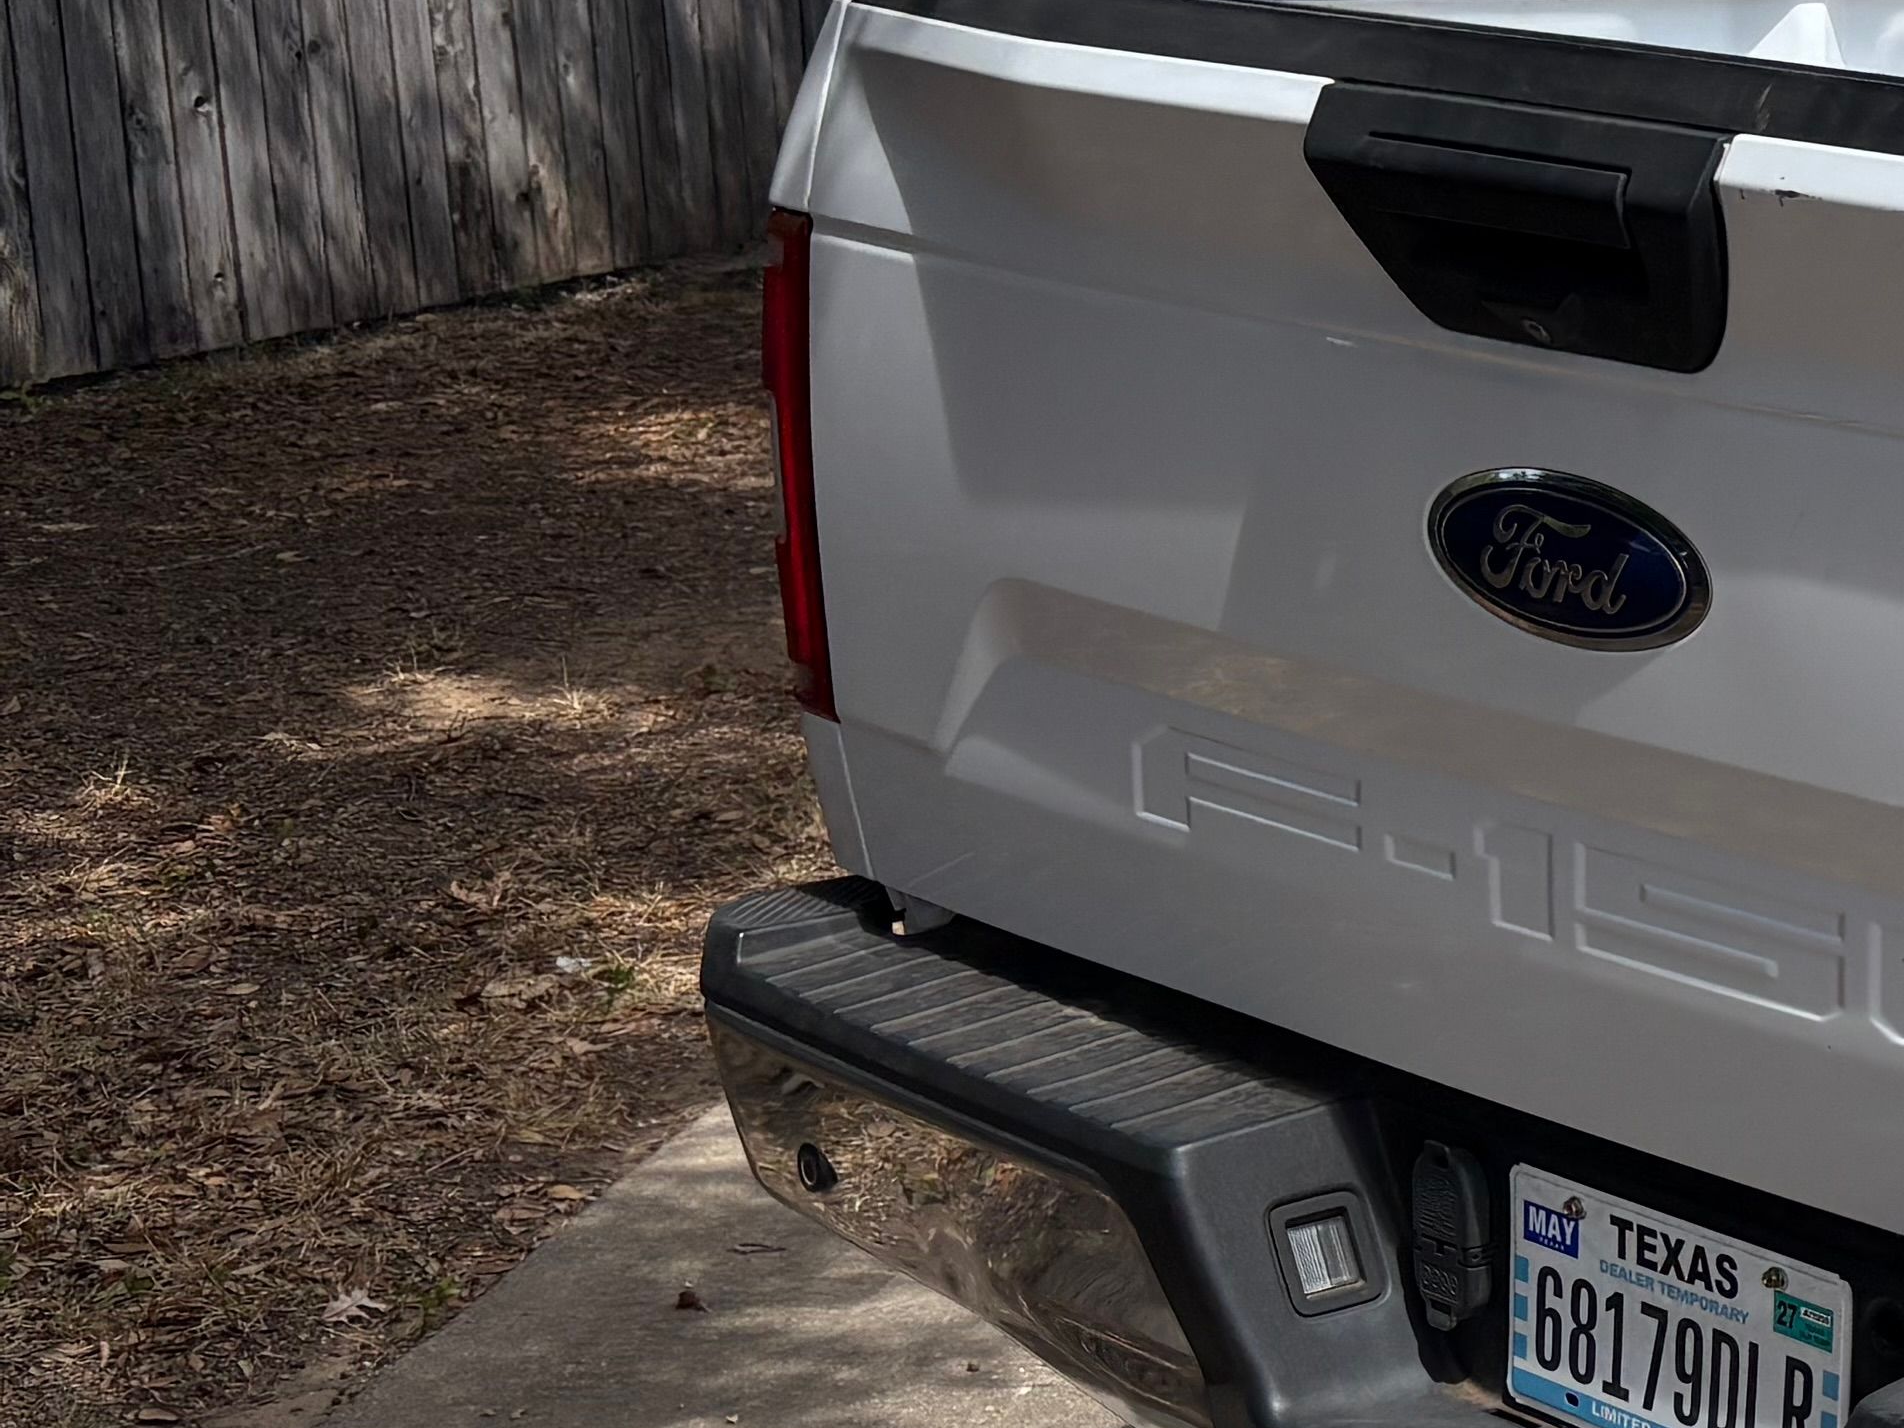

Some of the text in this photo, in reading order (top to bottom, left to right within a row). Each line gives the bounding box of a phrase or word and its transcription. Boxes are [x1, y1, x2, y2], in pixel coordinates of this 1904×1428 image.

[1480, 504, 1630, 615] Ford
[1528, 1205, 1576, 1246] MAY
[1608, 1214, 1739, 1300] TEXAS
[1599, 1258, 1750, 1326] DEALER TEMPORARY
[1776, 1300, 1798, 1329] 27
